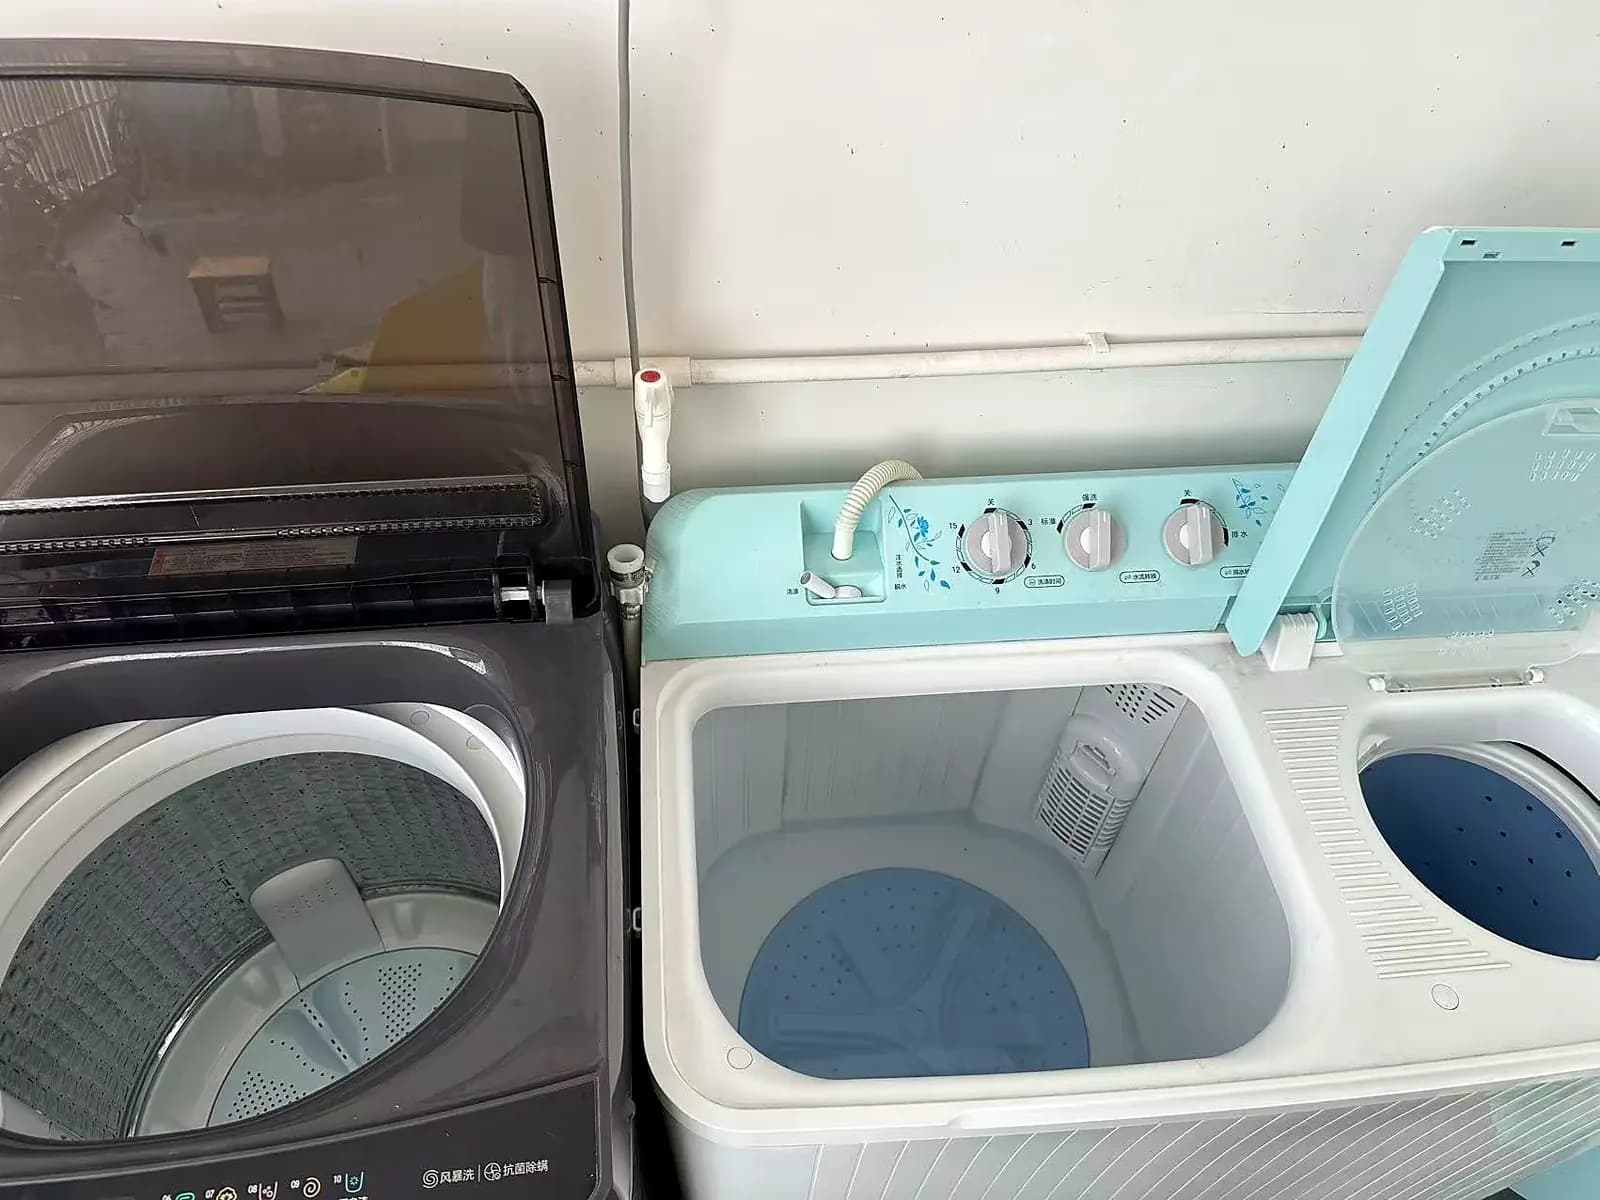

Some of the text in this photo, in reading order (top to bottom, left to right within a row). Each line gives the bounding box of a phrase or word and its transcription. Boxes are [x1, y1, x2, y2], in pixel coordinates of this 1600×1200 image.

[1184, 489, 1192, 497] 关
[987, 498, 995, 506] 关
[1041, 518, 1056, 526] 标准
[1231, 530, 1248, 538] 排水
[952, 566, 960, 574] 12
[1037, 578, 1062, 586] 洗涤时间
[440, 1160, 549, 1184] 风暴洗 抗菌除螨
[333, 1174, 342, 1183] 10
[248, 1184, 258, 1193] 08
[290, 1180, 300, 1189] 09
[205, 1189, 215, 1199] 07
